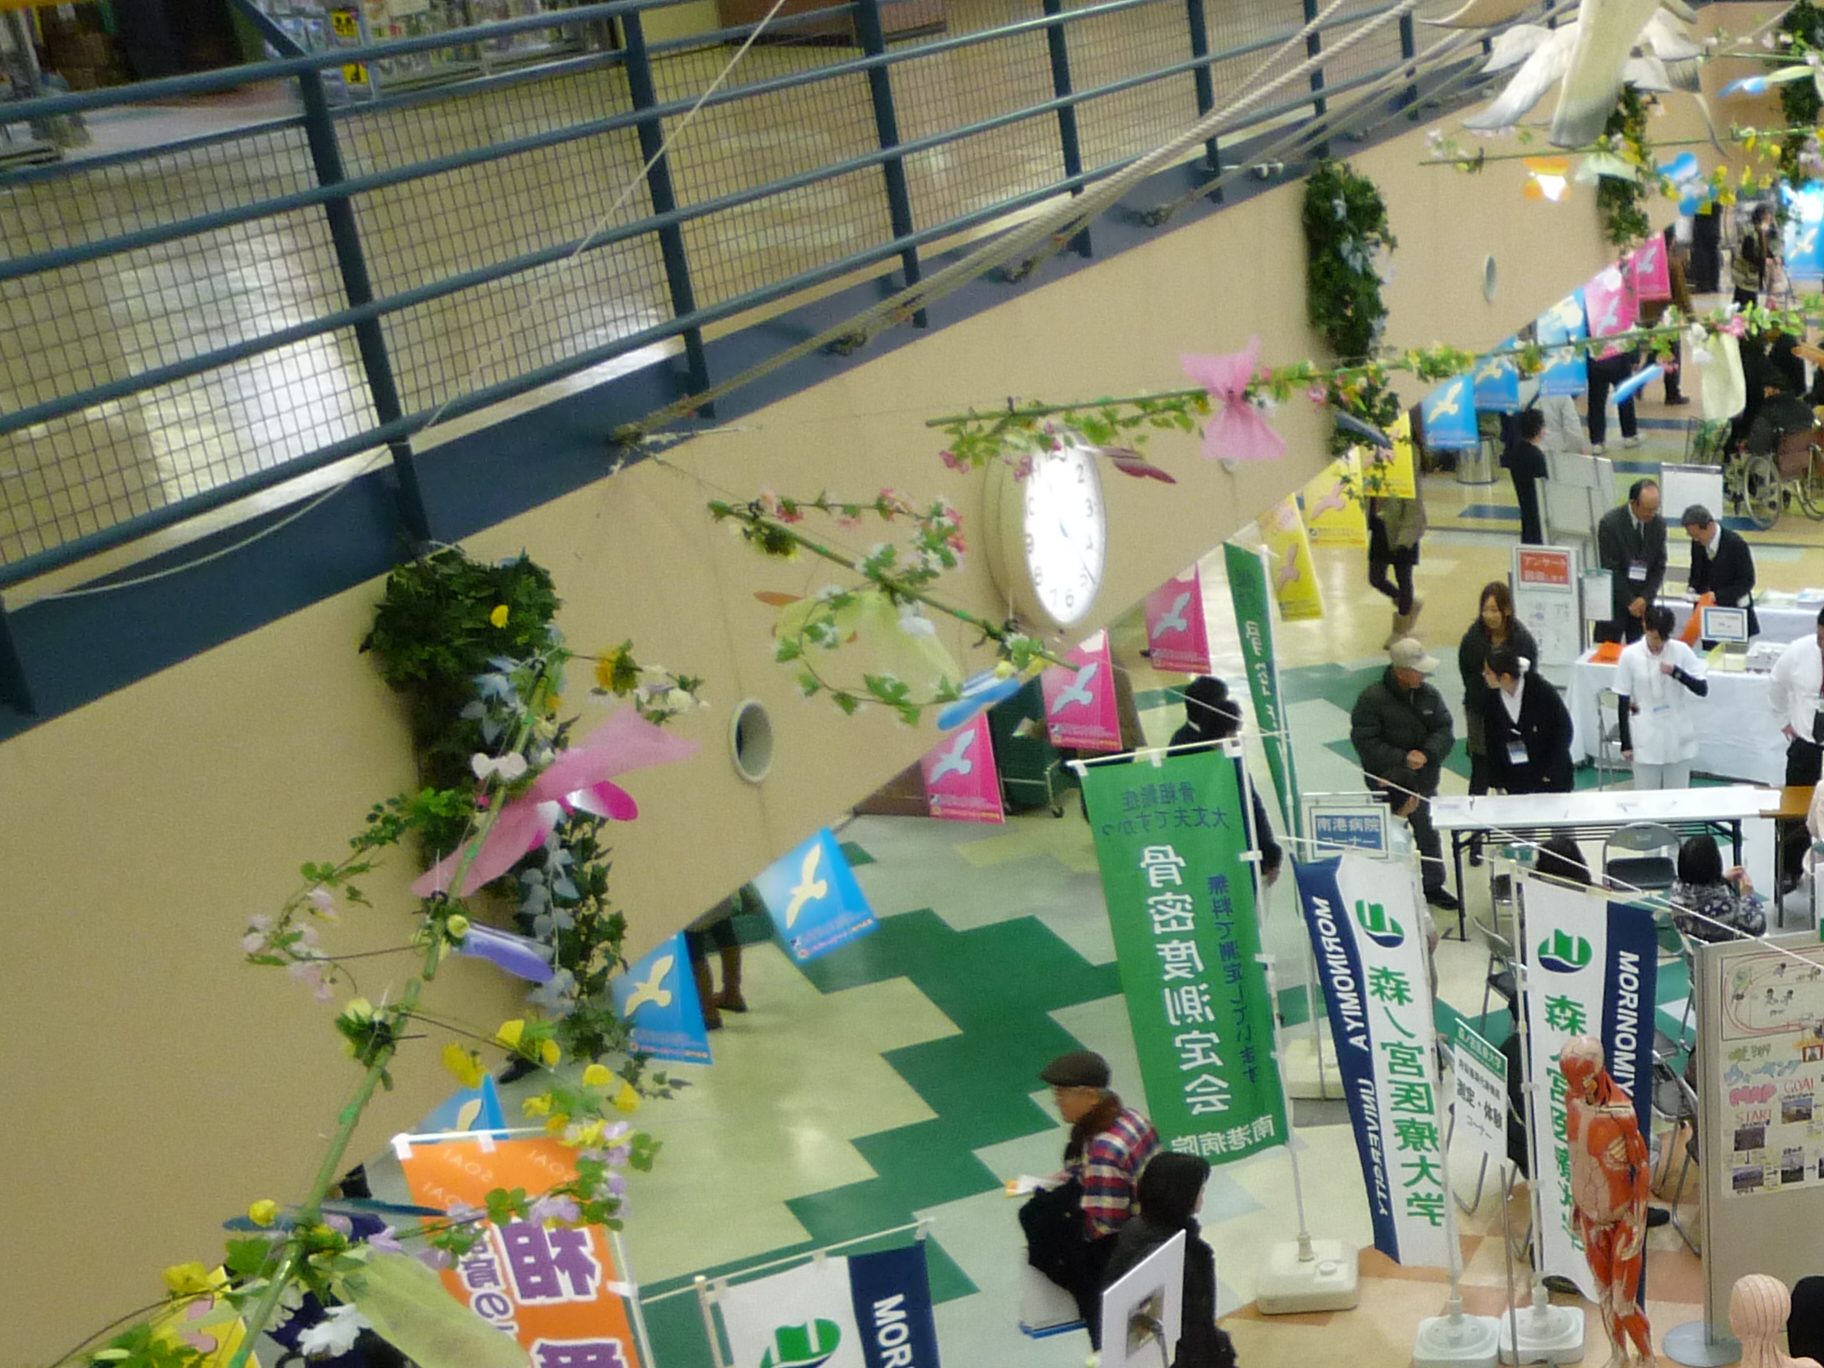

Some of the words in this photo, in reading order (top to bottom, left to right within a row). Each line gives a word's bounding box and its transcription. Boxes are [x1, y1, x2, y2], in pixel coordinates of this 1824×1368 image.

[1315, 813, 1381, 834] 南港病院
[1613, 949, 1641, 1098] MORINOMIY
[1466, 1114, 1493, 1140] コーナー
